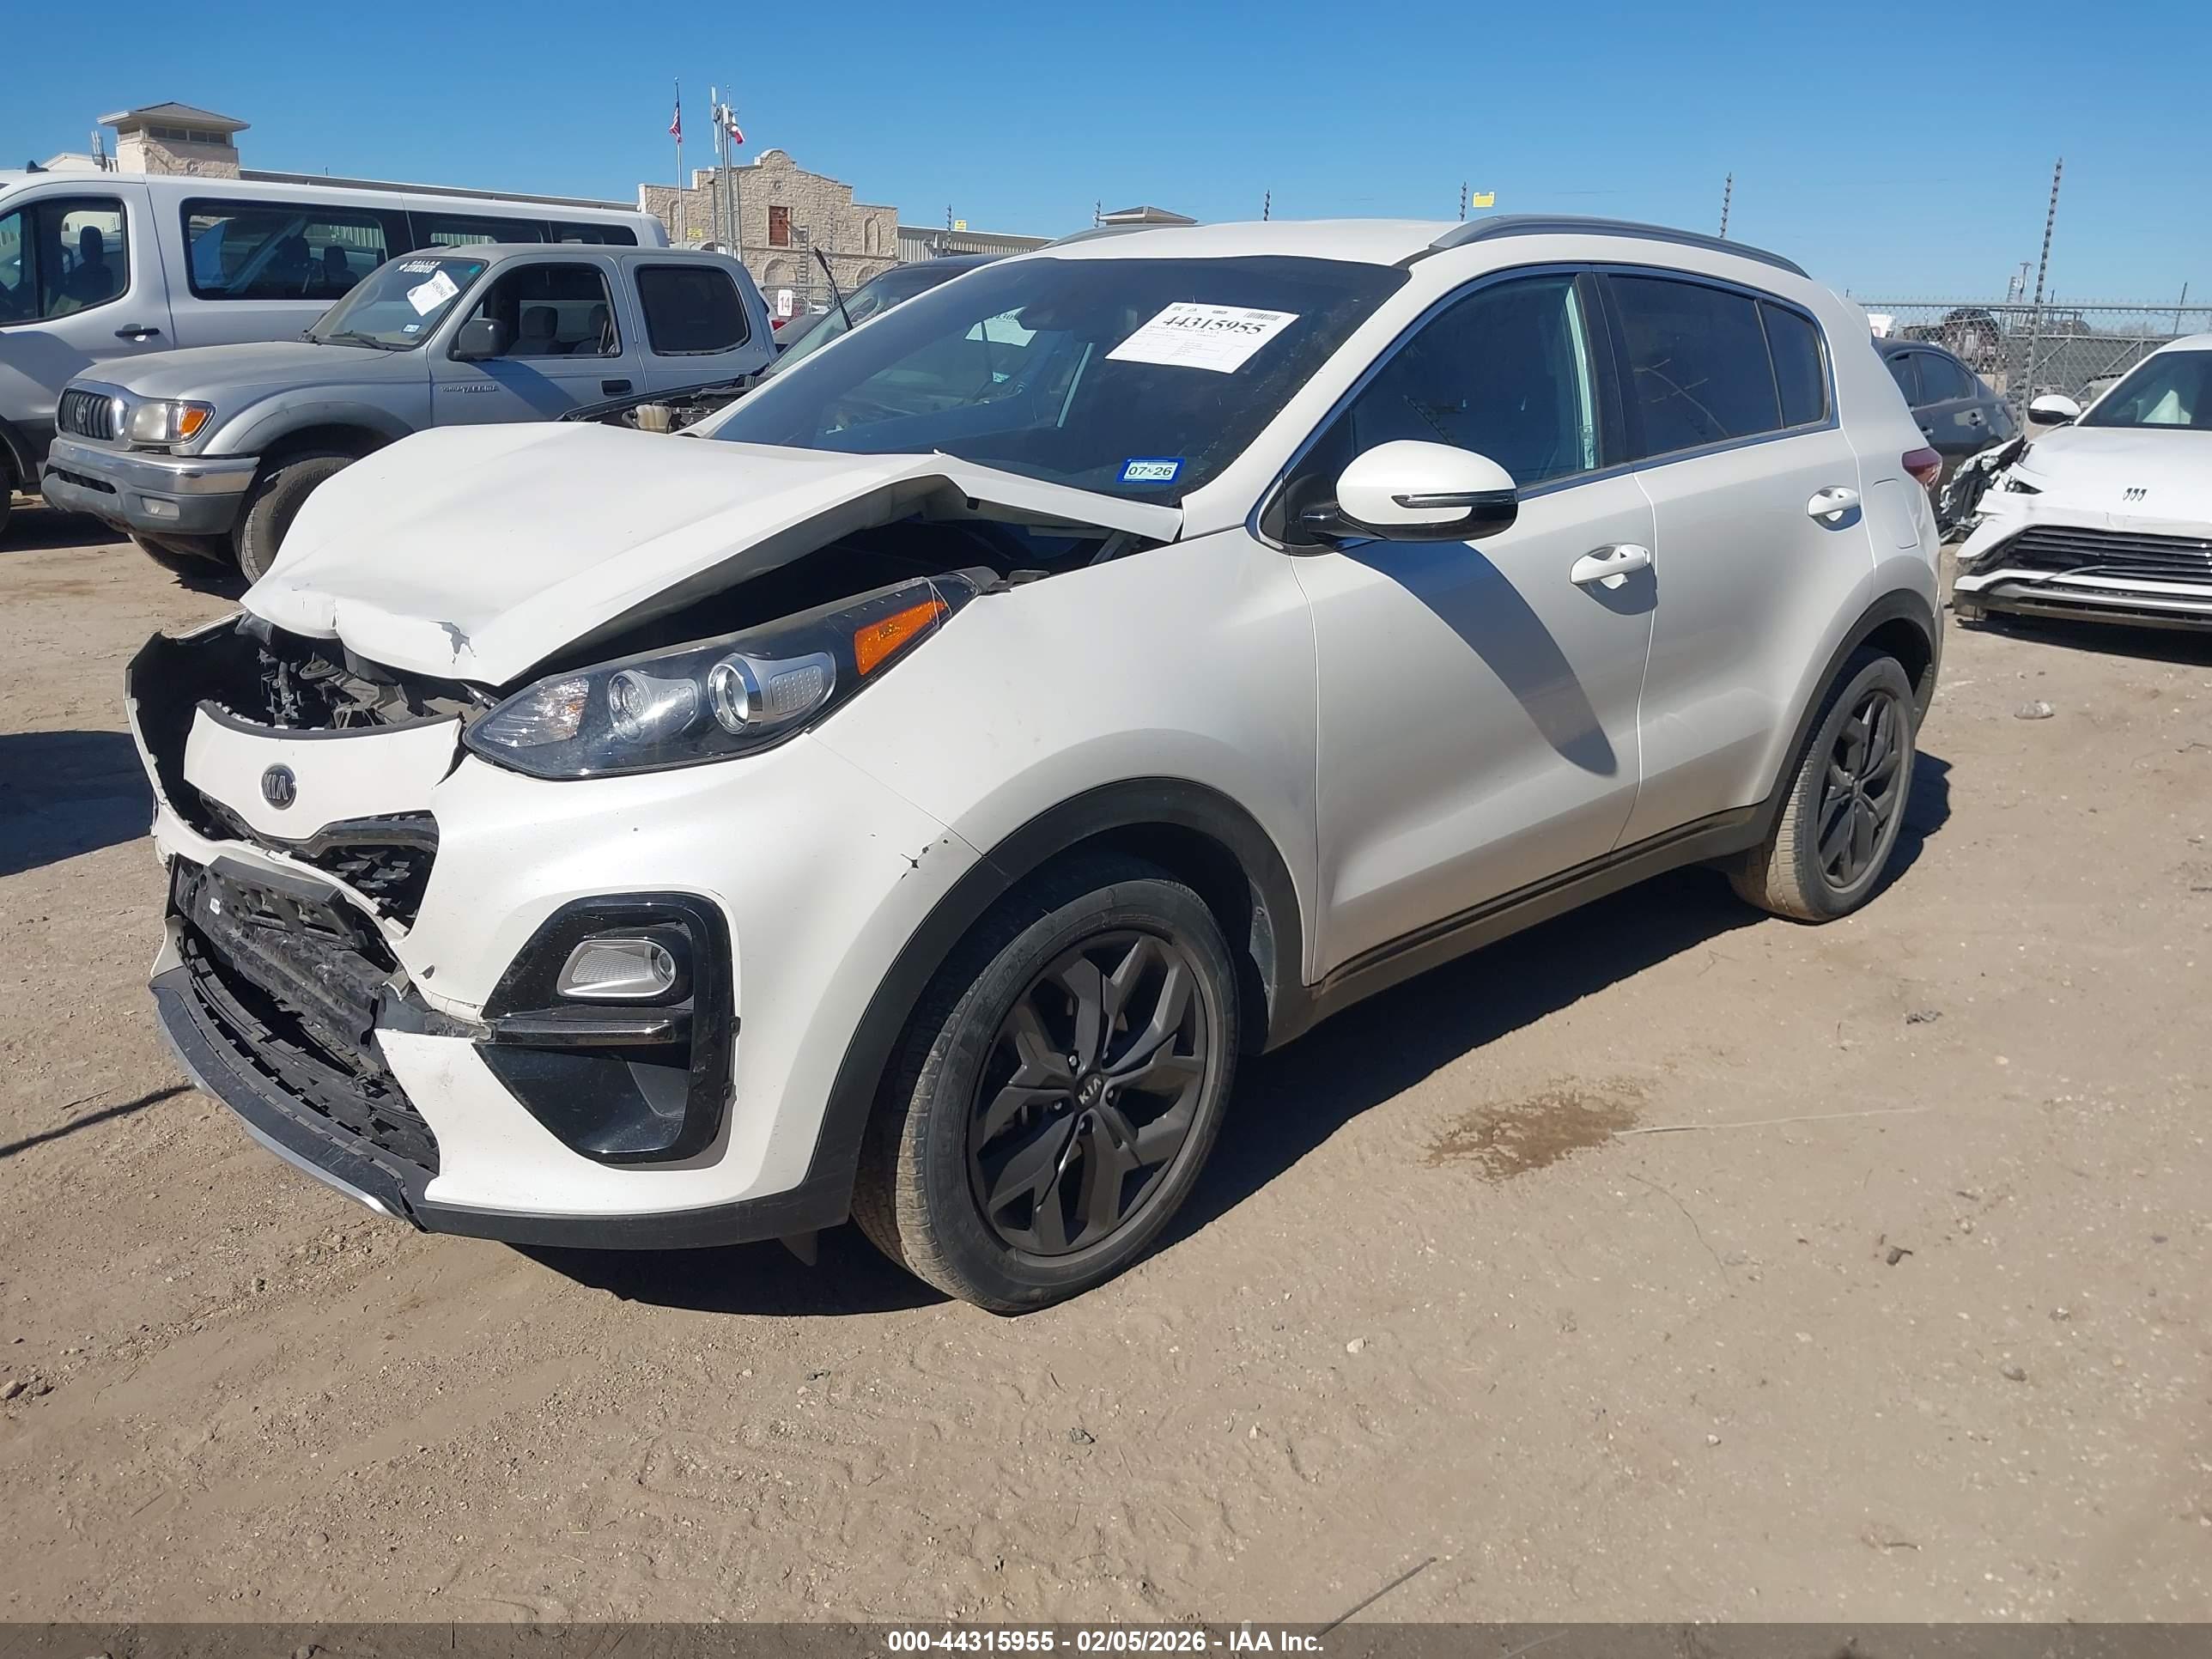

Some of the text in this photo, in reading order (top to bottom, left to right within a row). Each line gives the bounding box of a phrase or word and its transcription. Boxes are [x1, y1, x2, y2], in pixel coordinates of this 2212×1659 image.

[780, 295, 791, 311] 14
[1163, 315, 1267, 335] 44315955
[263, 773, 289, 800] KIA
[1078, 1078, 1102, 1105] KIA
